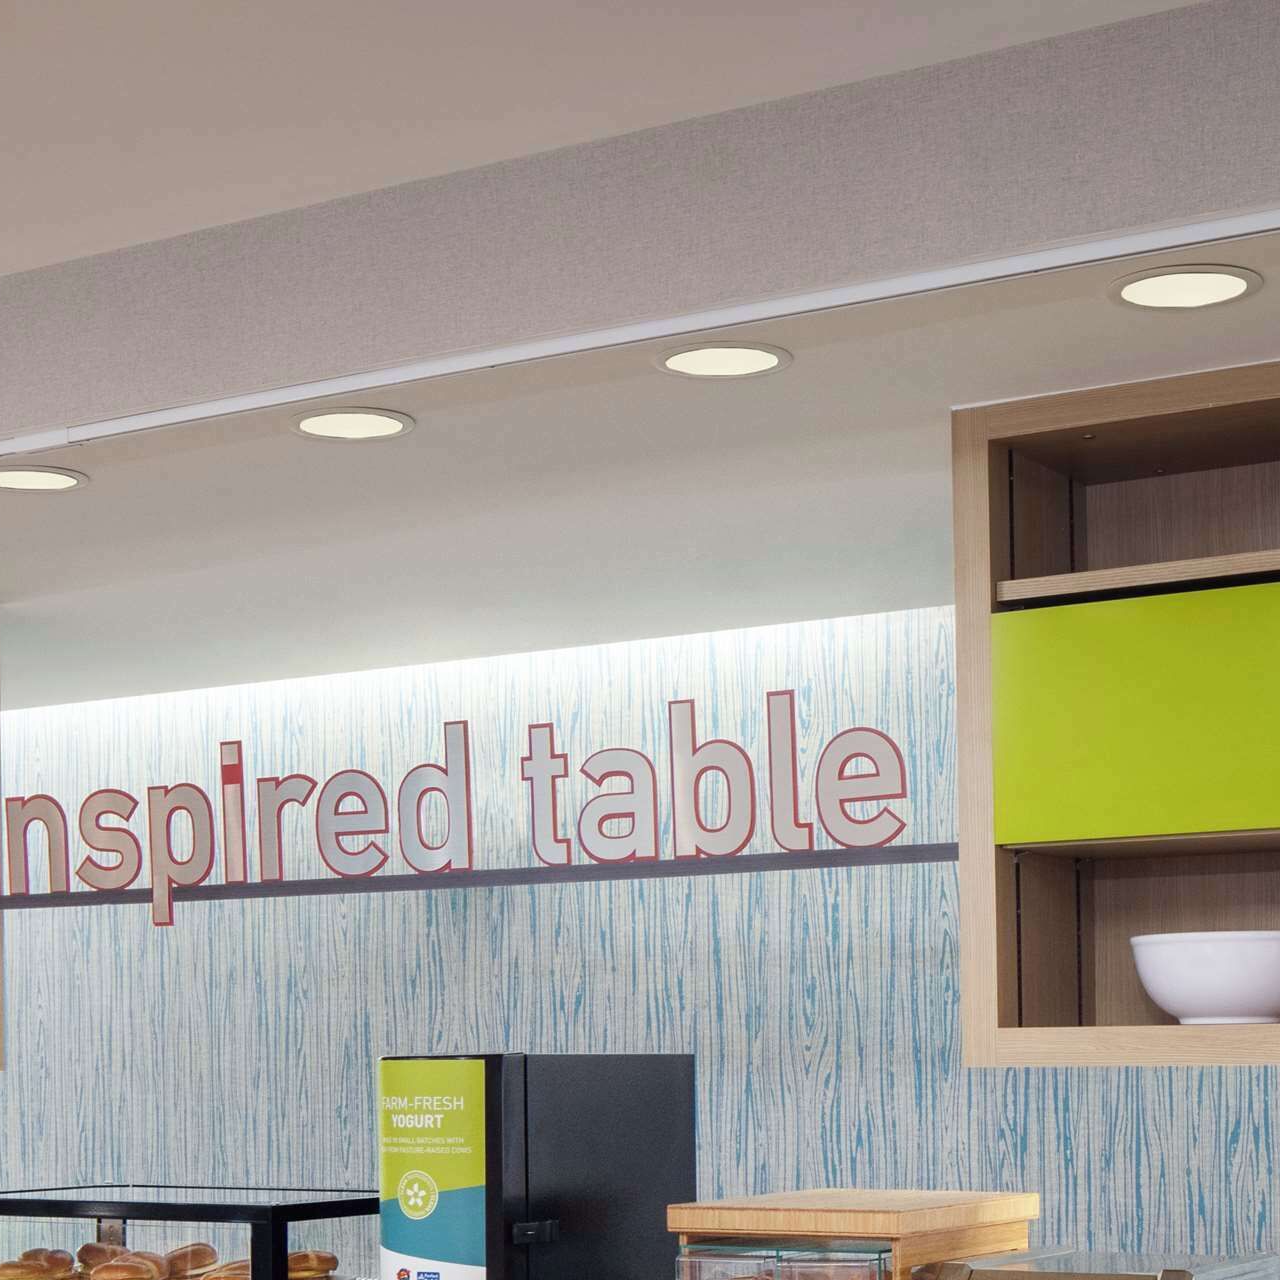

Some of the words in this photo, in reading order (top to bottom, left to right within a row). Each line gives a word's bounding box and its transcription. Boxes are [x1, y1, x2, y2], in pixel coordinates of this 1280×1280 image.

[519, 689, 908, 866] table
[381, 1095, 465, 1111] FARM-FRESH
[391, 1113, 445, 1129] YOGURT
